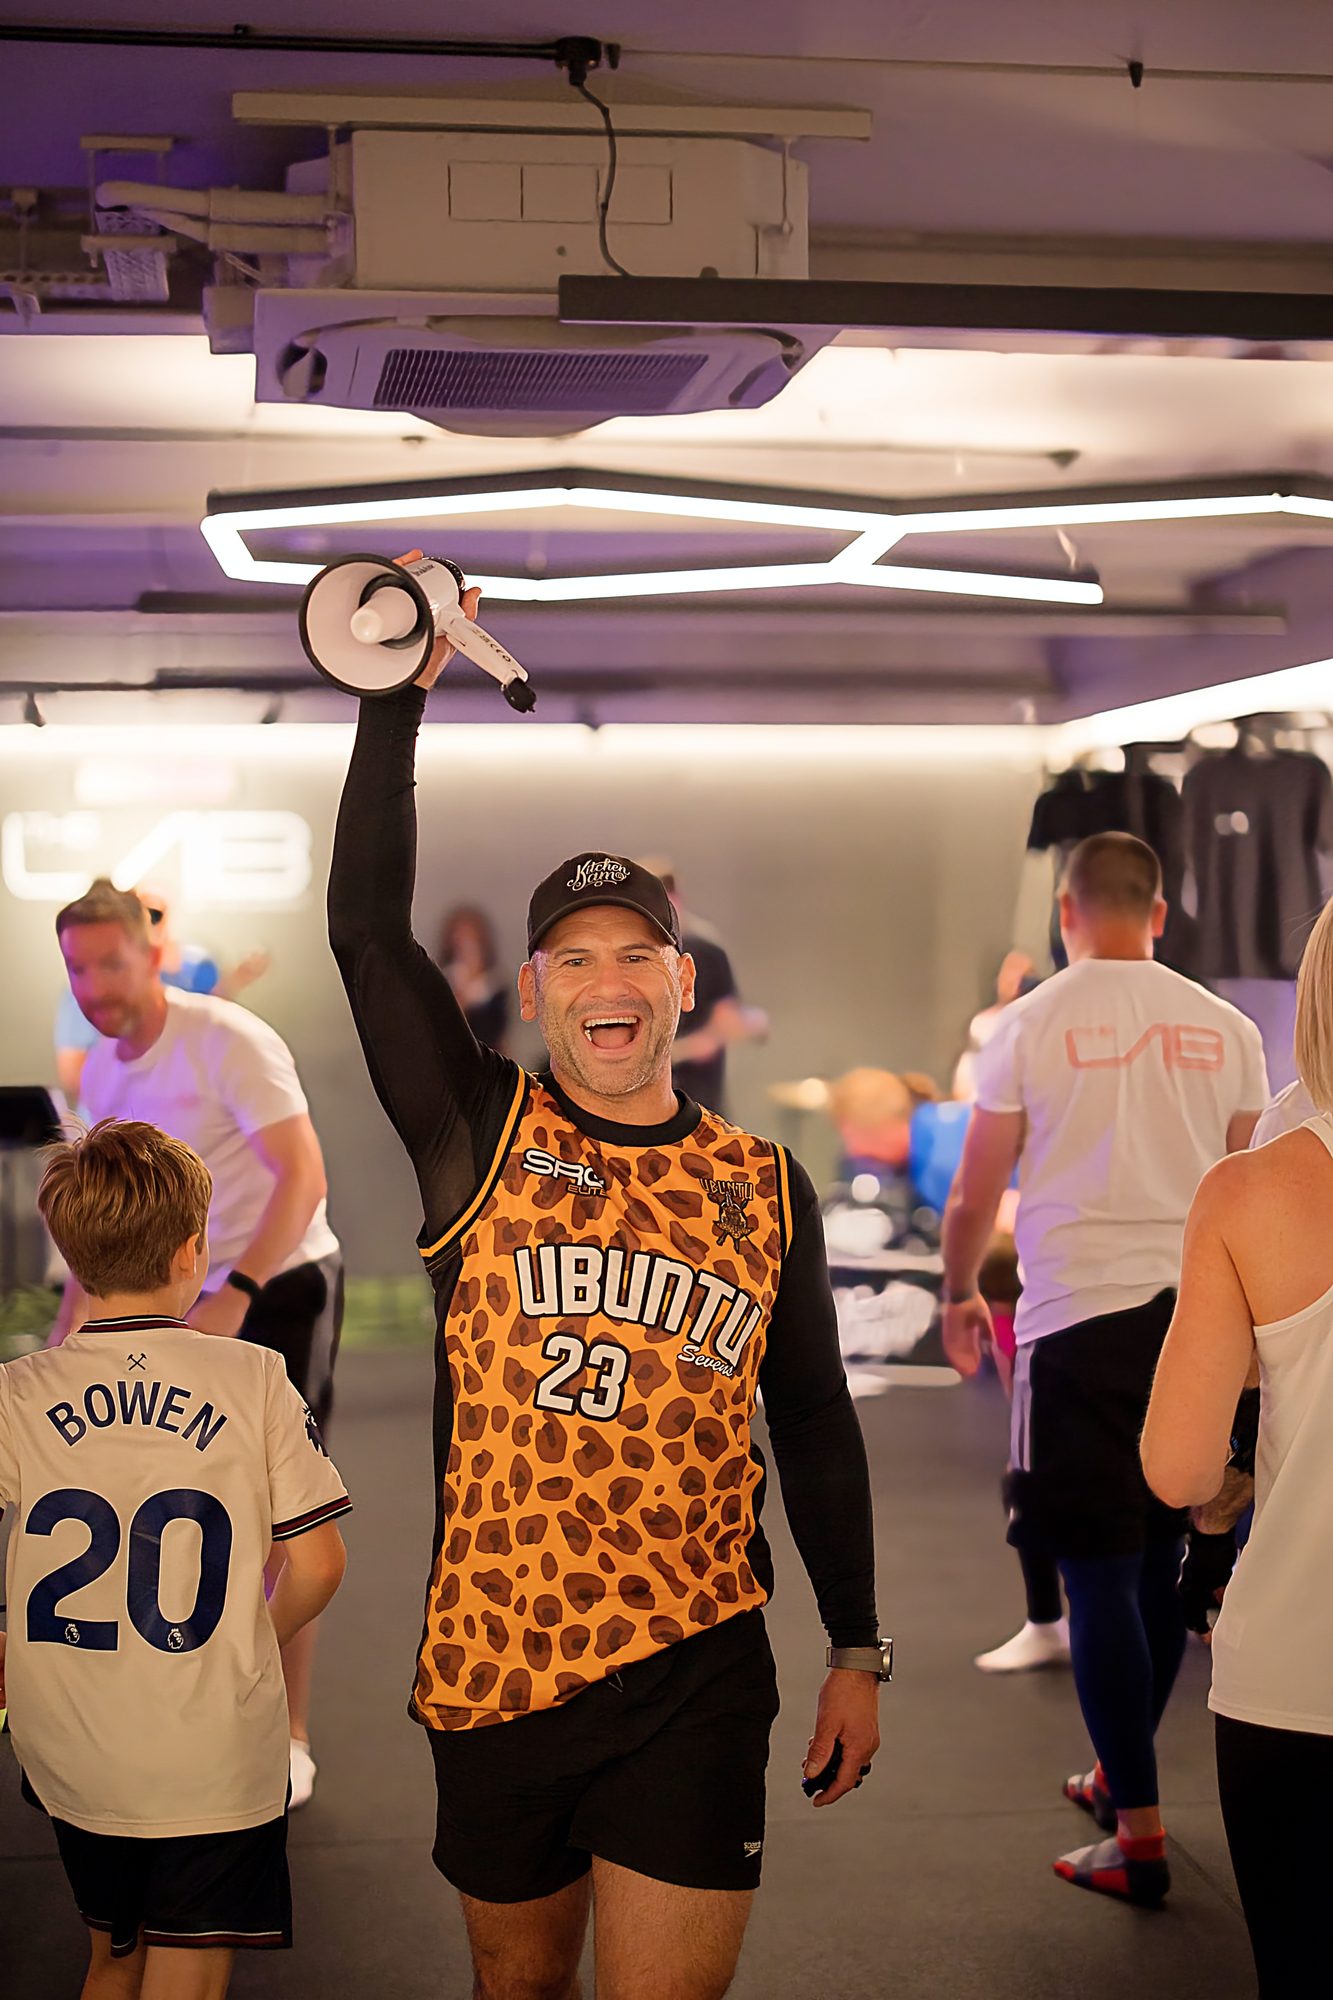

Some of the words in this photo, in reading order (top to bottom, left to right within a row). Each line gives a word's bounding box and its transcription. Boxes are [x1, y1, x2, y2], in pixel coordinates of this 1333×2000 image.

[572, 858, 631, 886] Kitchen
[699, 1178, 754, 1201] UBUNTU
[514, 1244, 763, 1368] UBUNTU
[535, 1333, 629, 1420] 23
[677, 1343, 735, 1377] Sevens
[45, 1380, 229, 1453] BOWEN
[25, 1487, 235, 1655] 20
